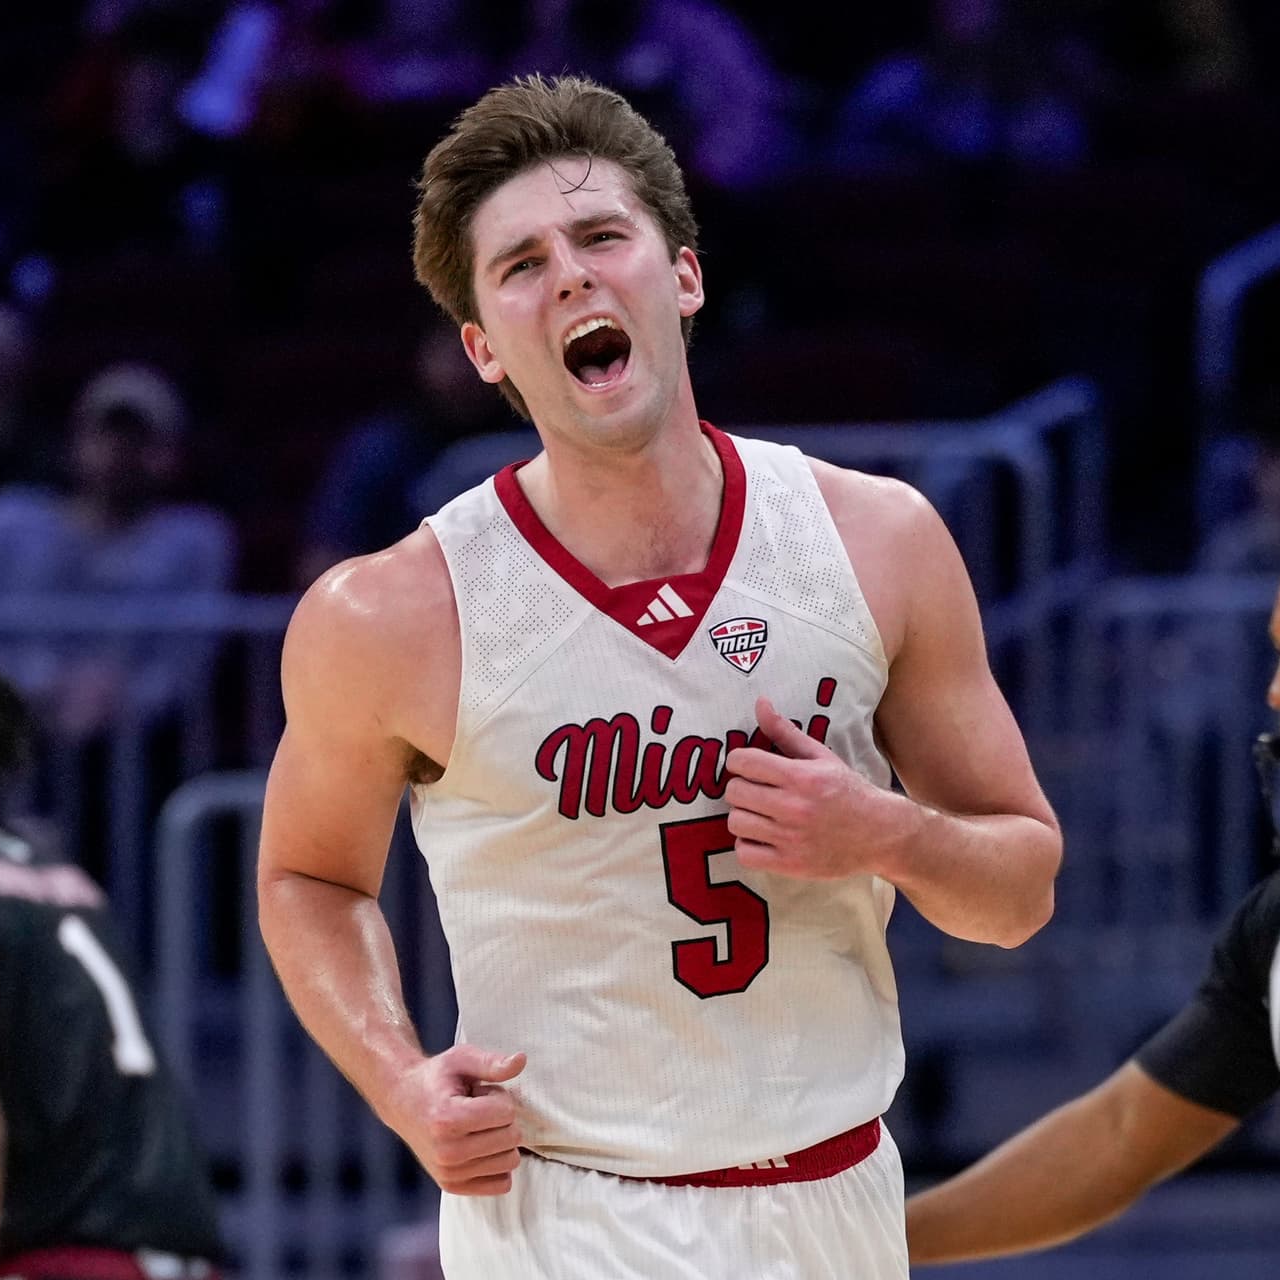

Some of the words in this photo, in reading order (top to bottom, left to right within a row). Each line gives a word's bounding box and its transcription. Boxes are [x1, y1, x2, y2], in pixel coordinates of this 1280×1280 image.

[716, 632, 767, 653] MAC
[659, 813, 770, 999] 5
[57, 913, 155, 1076] 1
